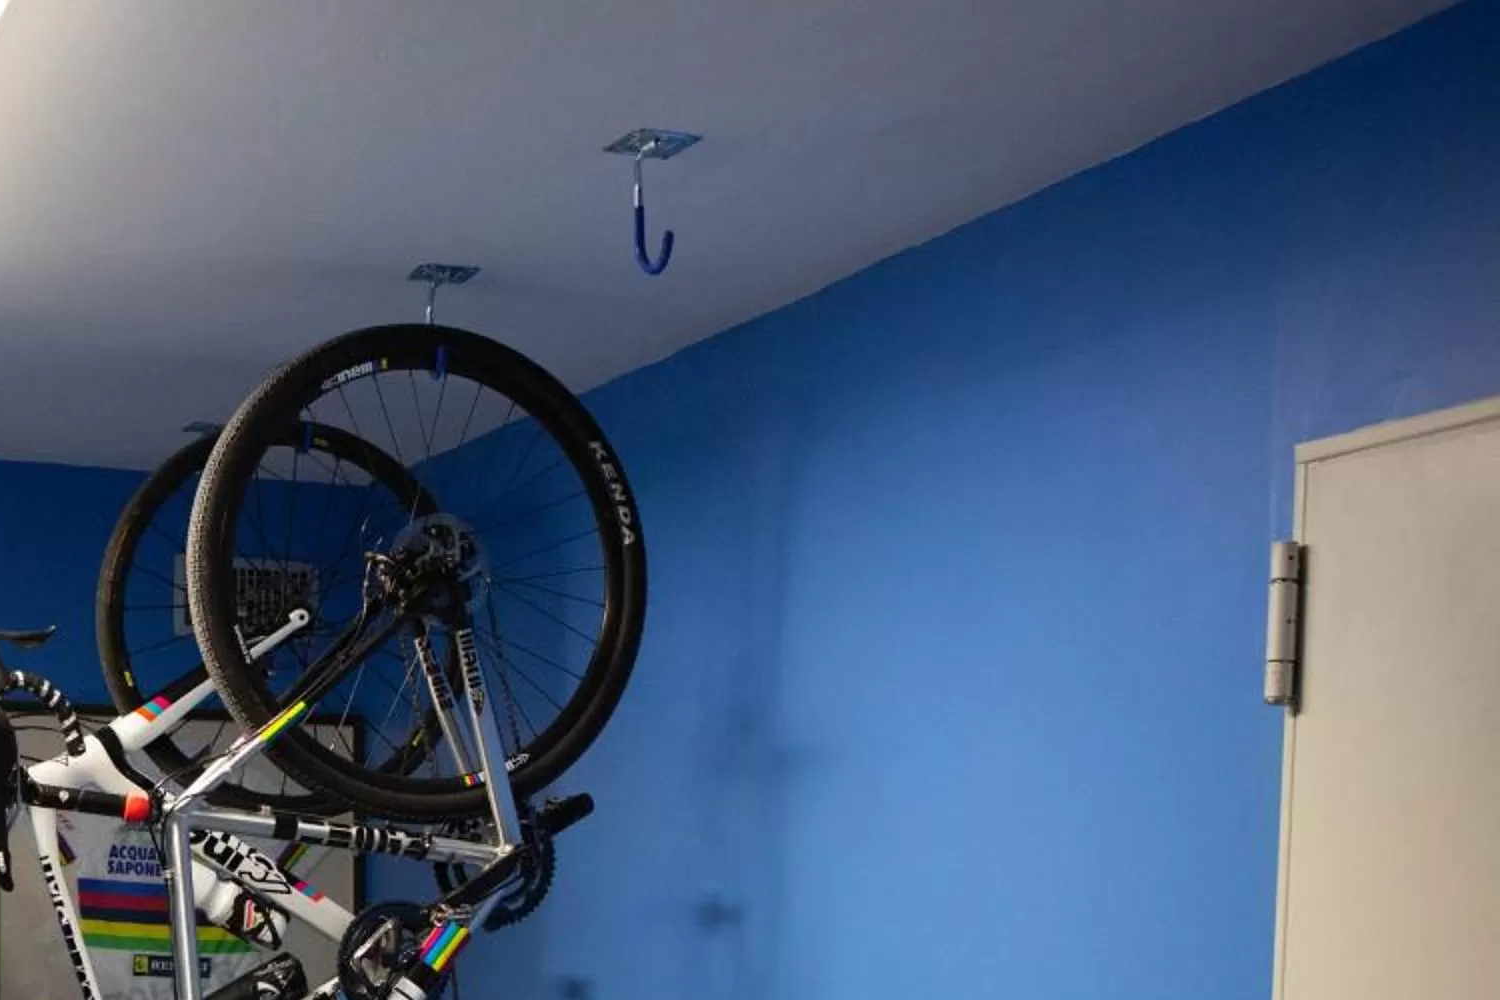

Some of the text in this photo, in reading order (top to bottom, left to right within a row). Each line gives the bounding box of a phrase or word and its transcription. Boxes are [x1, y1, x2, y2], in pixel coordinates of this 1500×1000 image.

[588, 440, 636, 546] KENDA
[109, 844, 159, 862] ACQUA
[107, 860, 165, 877] SAPONE
